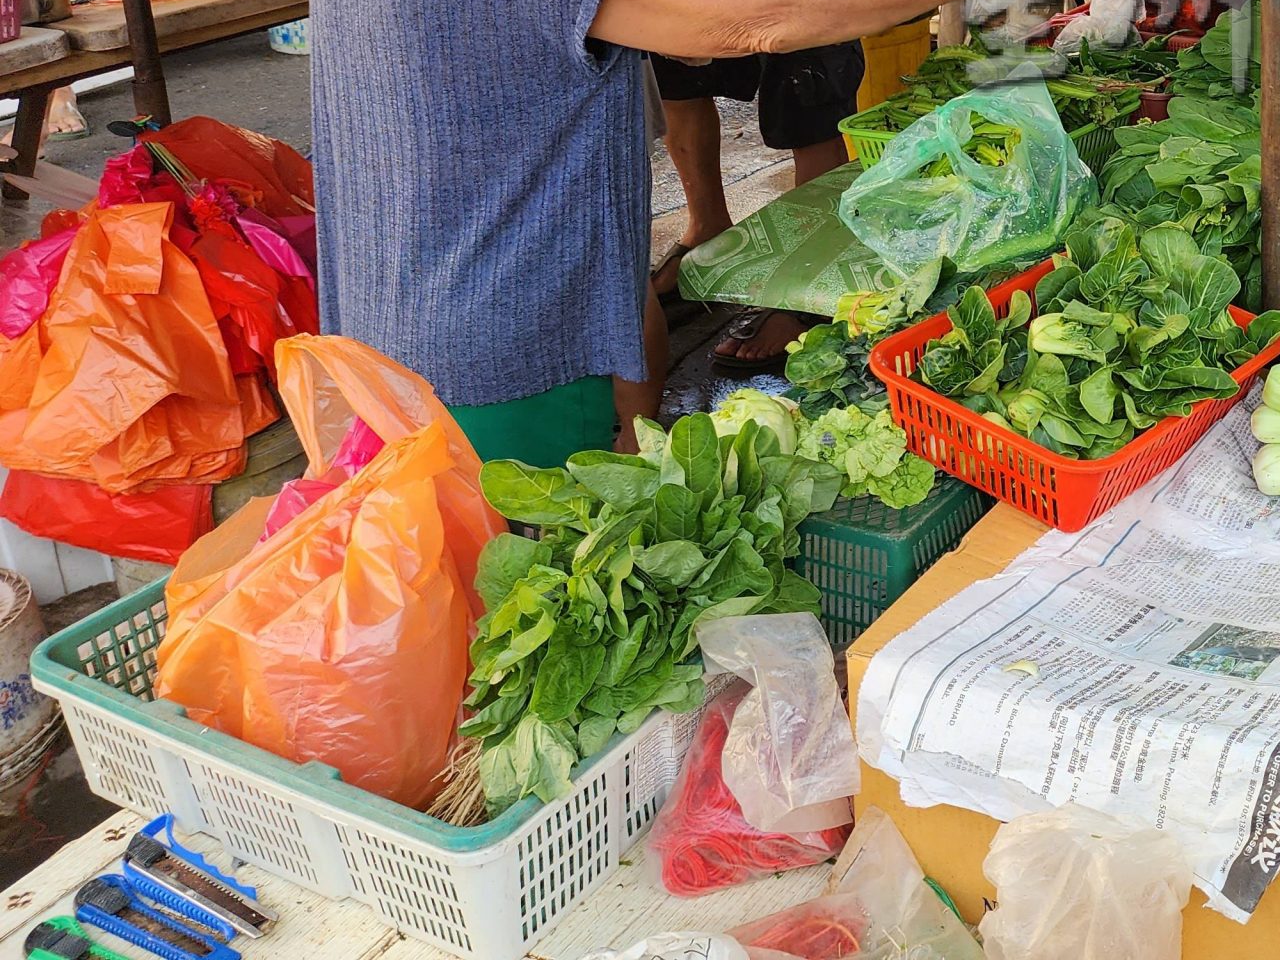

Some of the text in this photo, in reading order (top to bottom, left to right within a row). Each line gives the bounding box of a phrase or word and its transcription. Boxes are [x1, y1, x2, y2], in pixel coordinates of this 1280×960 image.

[947, 692, 965, 727] BERHAD
[1005, 707, 1018, 730] Block
[1167, 741, 1182, 765] Lama,
[1157, 766, 1175, 803] Petaling,
[1261, 787, 1273, 803] TO
[1153, 803, 1168, 830] 58200
[1242, 803, 1267, 857] PURCHASE)
